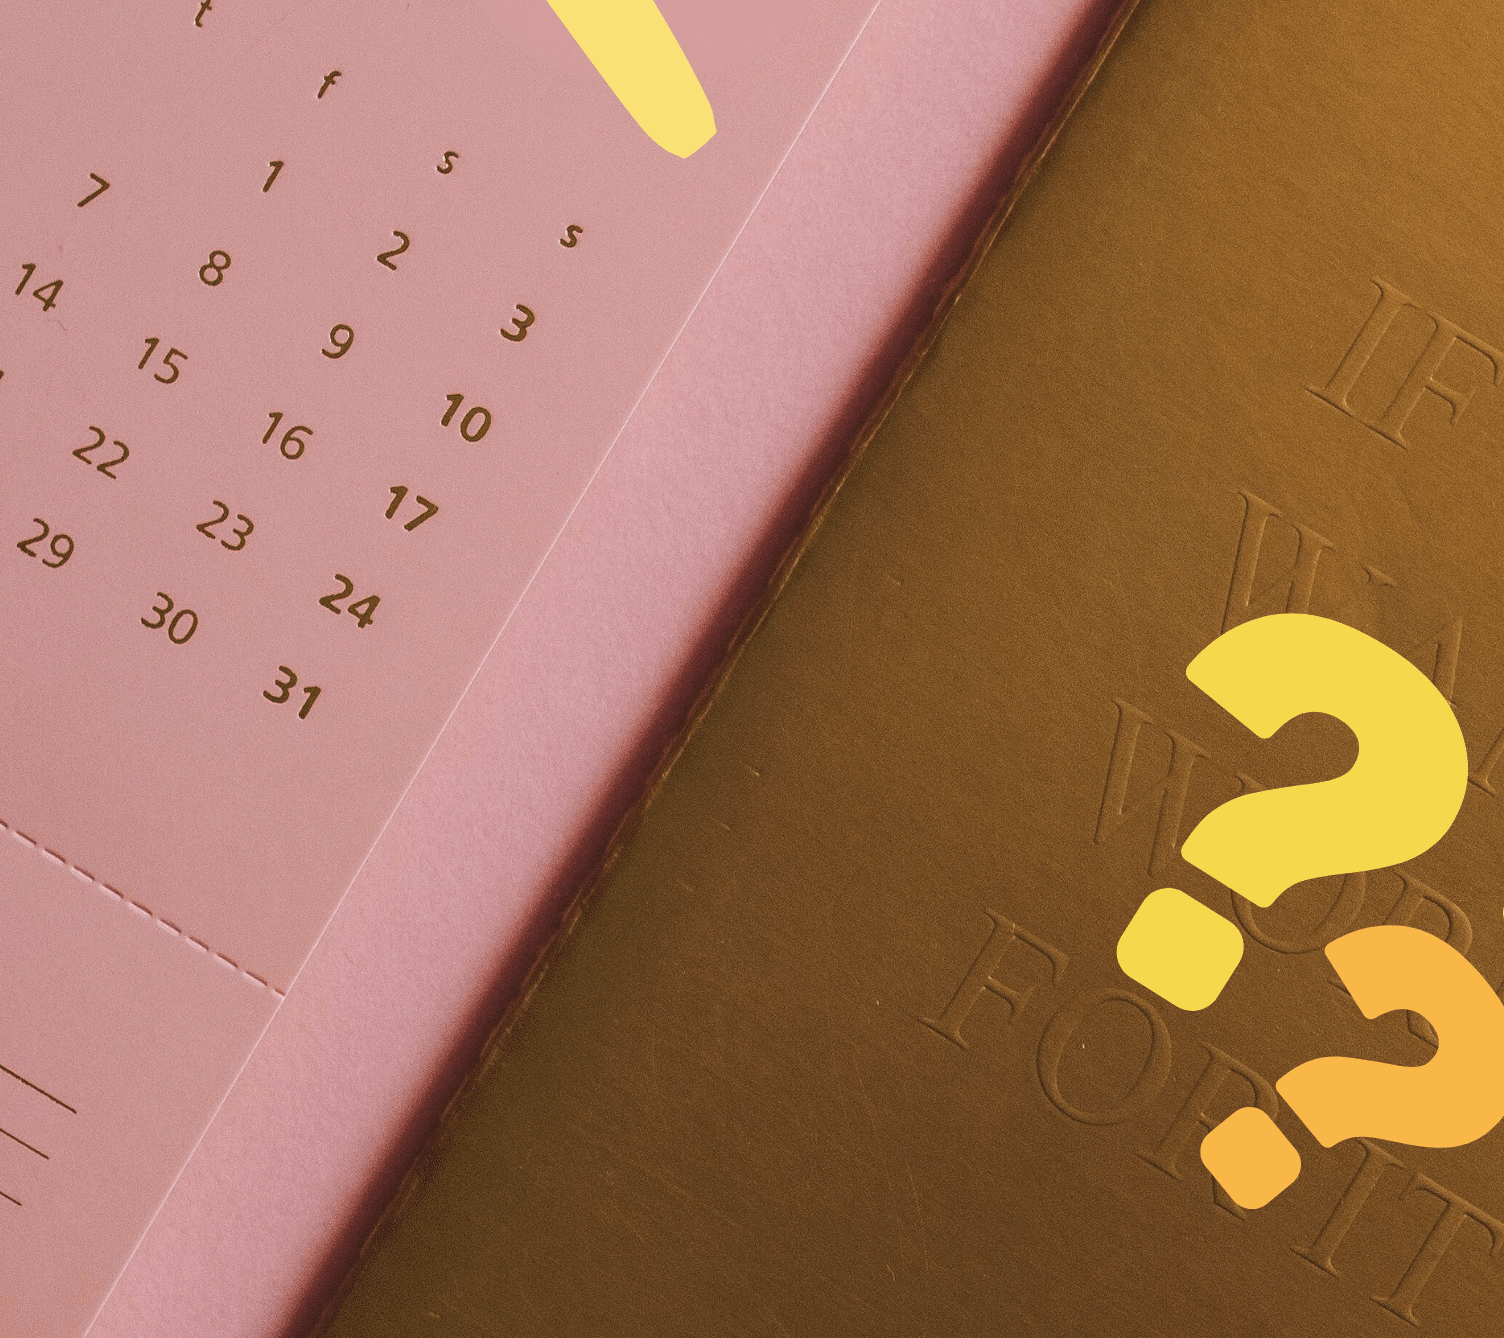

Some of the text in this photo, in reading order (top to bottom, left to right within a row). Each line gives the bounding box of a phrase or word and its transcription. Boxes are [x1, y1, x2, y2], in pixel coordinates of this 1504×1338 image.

[195, 0, 212, 27] t
[318, 71, 342, 98] f
[437, 151, 459, 174] s
[560, 225, 583, 248] s
[78, 173, 110, 207] 7
[199, 250, 231, 286] 8
[322, 324, 354, 359] 9
[441, 394, 491, 442] 10
[263, 161, 535, 341] 1 2 3
[15, 263, 63, 311] 14
[138, 338, 187, 384] 15
[263, 412, 313, 459] 16
[386, 486, 439, 531] 17
[17, 518, 74, 568] 29
[141, 592, 198, 644] 30
[263, 666, 321, 719] 31
[73, 426, 129, 479] 22
[196, 501, 254, 550] 23
[319, 574, 380, 628] 24
